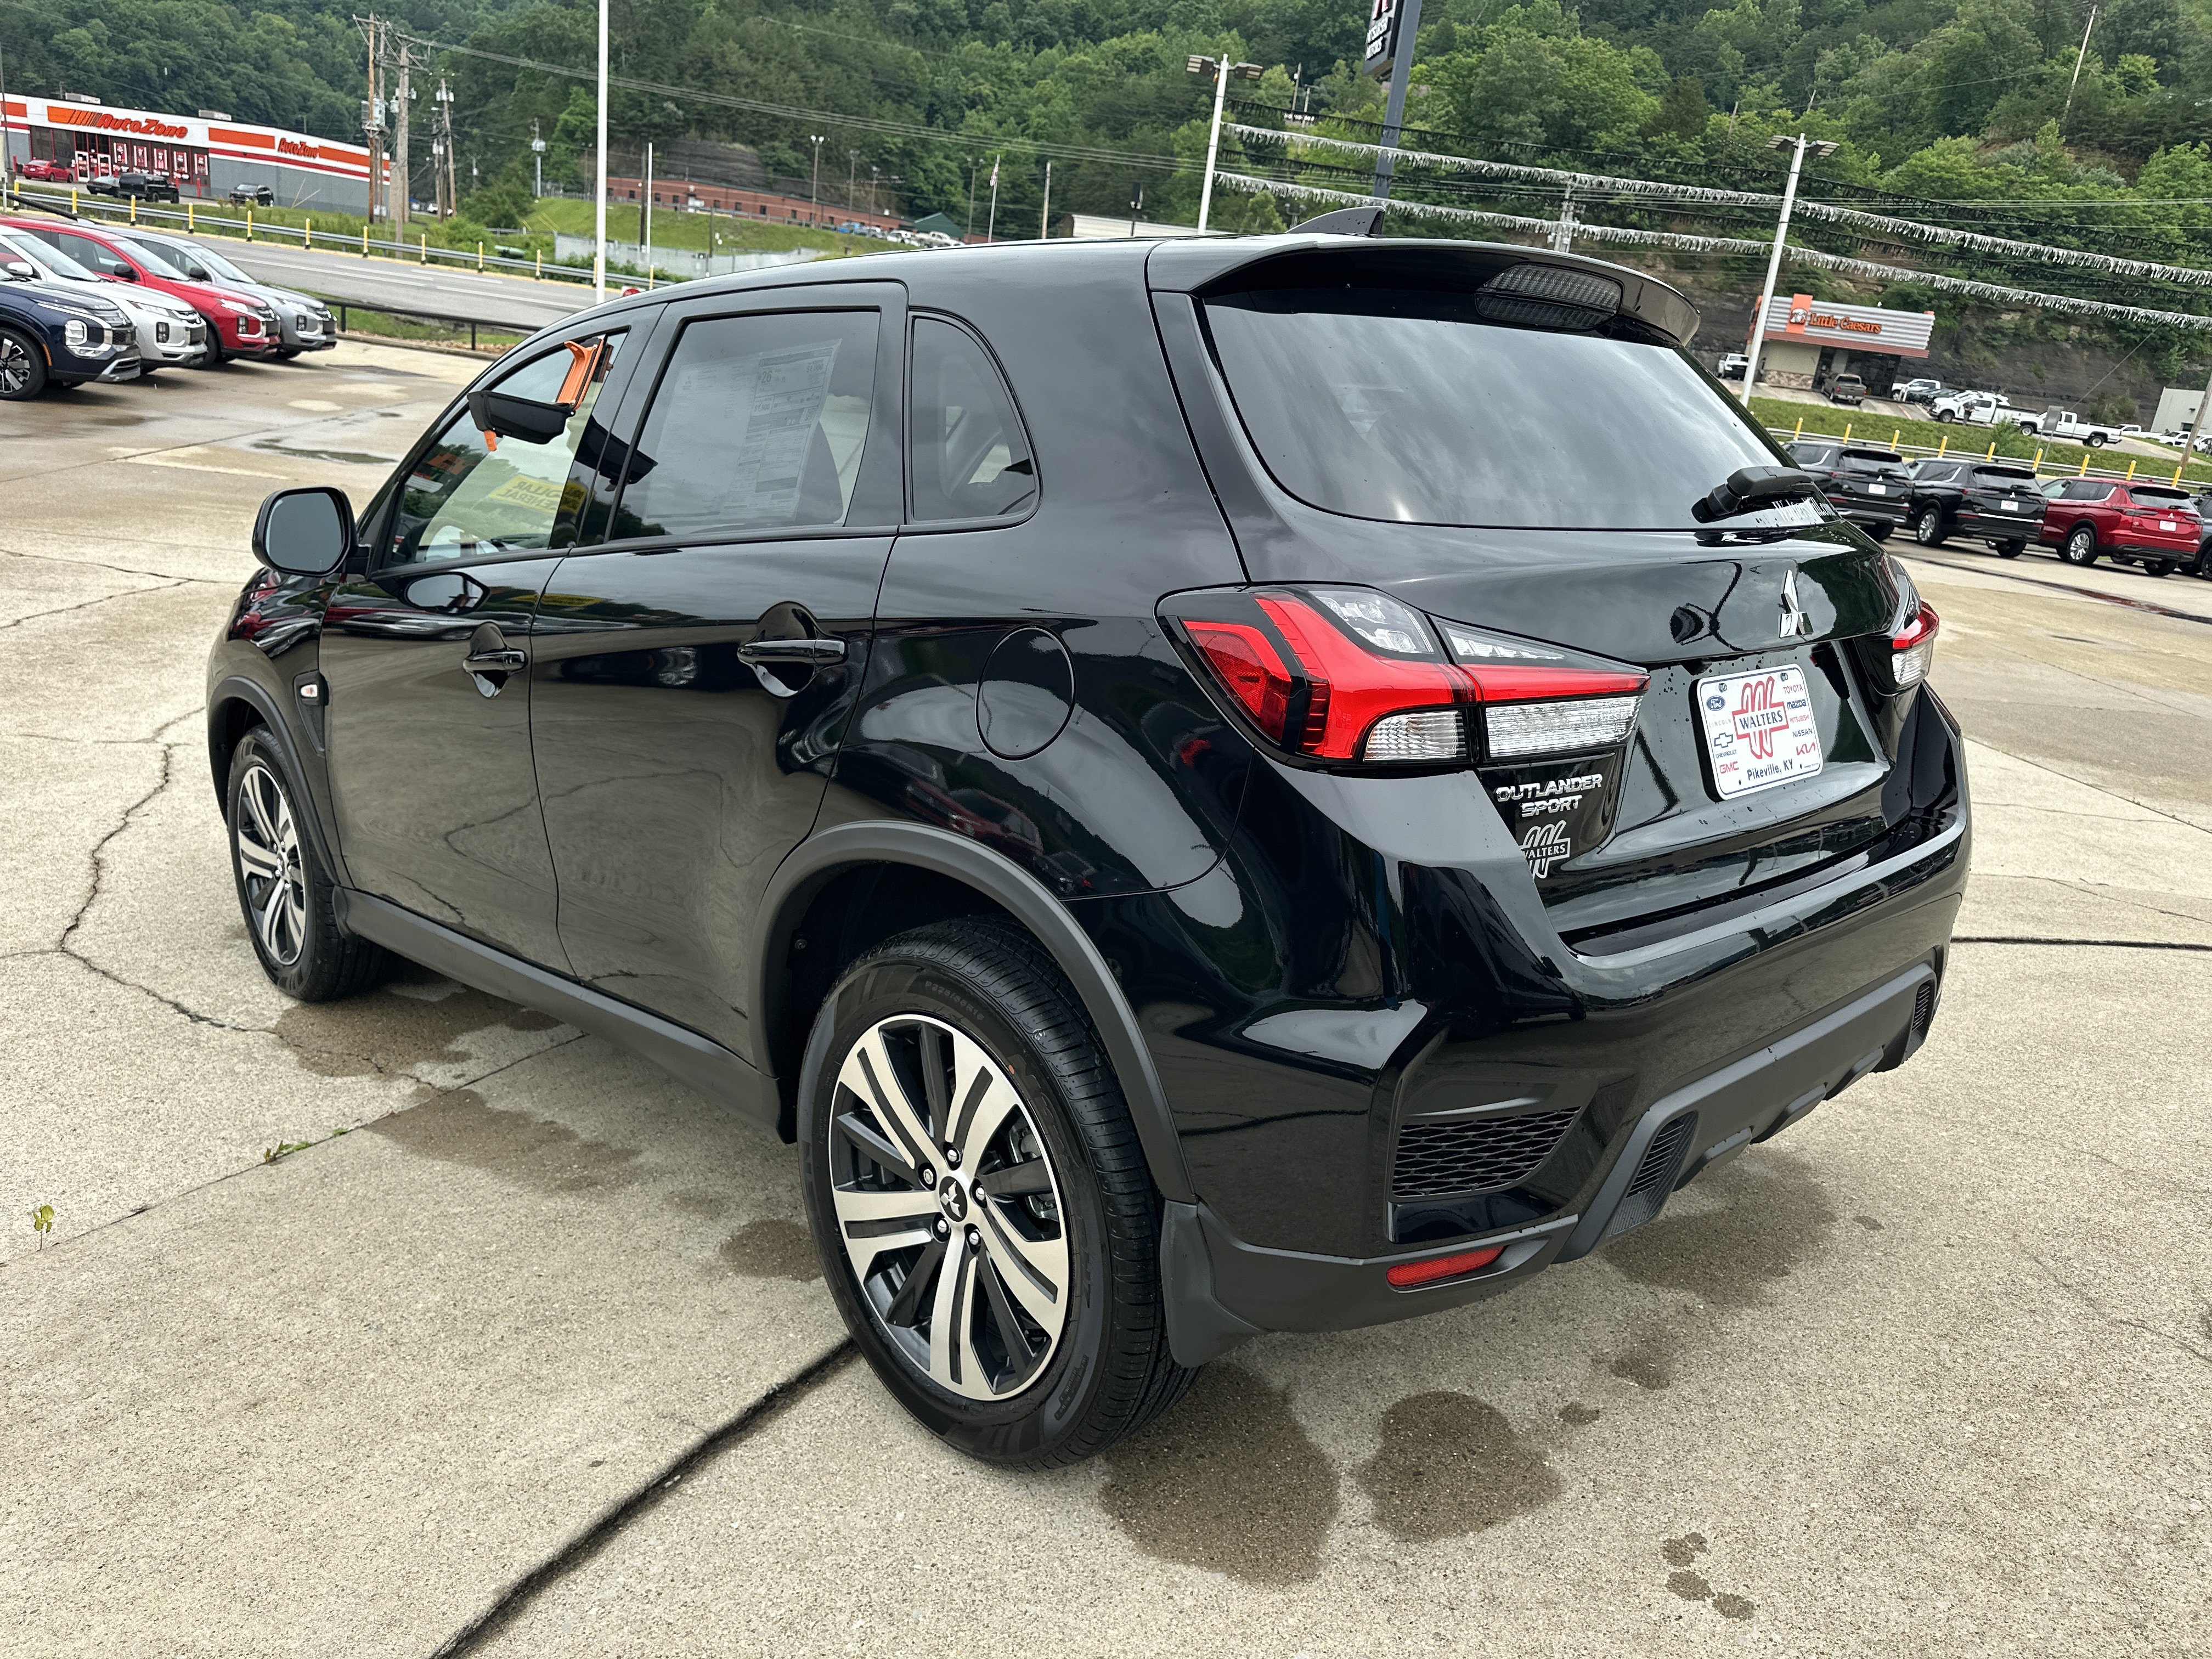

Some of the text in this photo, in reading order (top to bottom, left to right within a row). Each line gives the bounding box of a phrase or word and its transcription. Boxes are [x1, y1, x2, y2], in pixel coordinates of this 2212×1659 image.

[97, 113, 188, 138] AutoZone
[278, 138, 320, 159] AutoZone
[1810, 313, 1882, 334] Little Caesars
[1783, 684, 1803, 695] TOYOTA
[1708, 718, 1731, 727] LINCOLN
[1739, 710, 1784, 730] WALTERS
[1792, 728, 1813, 738] NISSAN
[1716, 749, 1737, 759] CHEVROLET
[1719, 761, 1739, 774] GMC
[1747, 764, 1782, 781] Pikeville,
[1783, 758, 1793, 771] KY
[1496, 773, 1603, 802] OUTLANDER
[1521, 794, 1582, 817] SPORT
